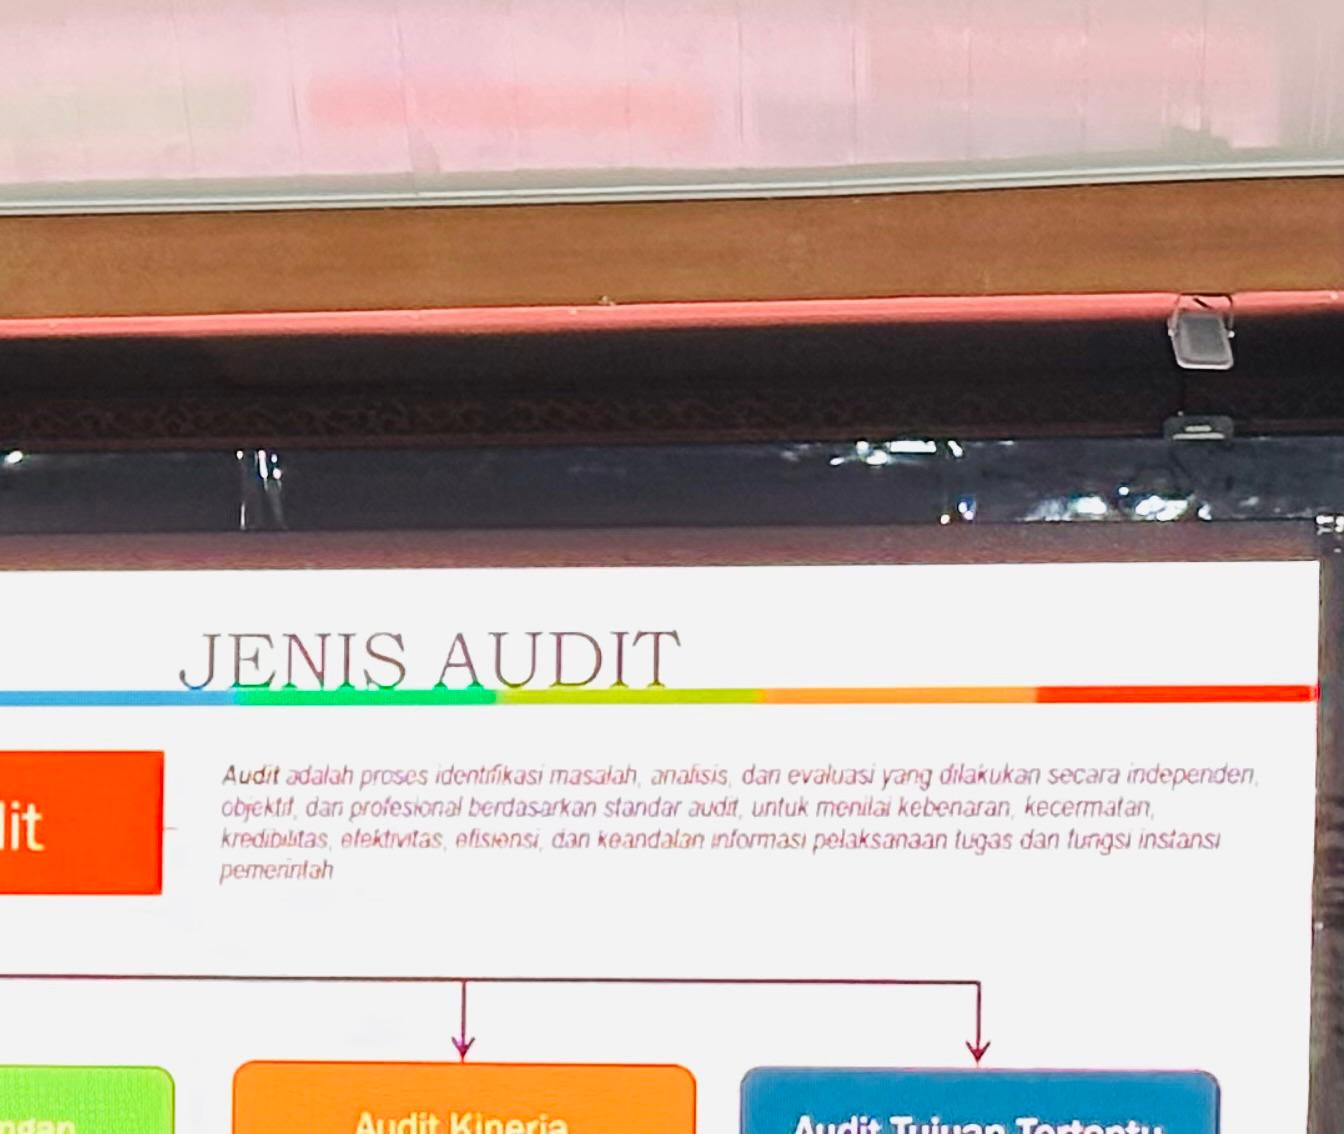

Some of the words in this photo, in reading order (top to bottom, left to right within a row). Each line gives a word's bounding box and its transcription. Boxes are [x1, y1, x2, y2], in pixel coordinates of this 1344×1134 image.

[179, 632, 407, 690] JENIS
[437, 630, 682, 688] AUDIT
[222, 764, 280, 785] Audit
[285, 764, 354, 785] adalah
[359, 767, 428, 791] proses
[435, 763, 544, 785] identifikasi
[549, 763, 642, 788] masalah,
[651, 763, 732, 788] analisis,
[742, 764, 781, 785] dan
[787, 763, 875, 785] evaluasi
[882, 766, 933, 791] yang
[939, 763, 1040, 785] dilakukan
[1047, 767, 1119, 785] secara
[1126, 762, 1259, 791] independen,
[221, 796, 297, 822] objektif,
[305, 797, 344, 818] dan
[348, 796, 464, 822] profesional
[468, 797, 596, 818] berdasarkan
[604, 797, 682, 818] standar
[688, 797, 742, 820] audit,
[752, 797, 808, 818] untuk
[816, 797, 891, 818] menilai
[898, 796, 1014, 820] kebenaran,
[1025, 796, 1154, 820] kecermatan,
[221, 829, 332, 851] kredibilitas,
[341, 829, 447, 851] efektivitas,
[455, 829, 543, 851] efisiensi,
[552, 829, 590, 849] dan
[598, 829, 705, 849] keandalan
[711, 829, 806, 849] informasi
[812, 829, 947, 855] pelaksanaan
[955, 829, 1012, 855] tugas
[1020, 829, 1059, 849] dan
[1067, 828, 1132, 855] fungsi
[1138, 828, 1221, 849] instansi
[219, 860, 334, 885] pemerintah
